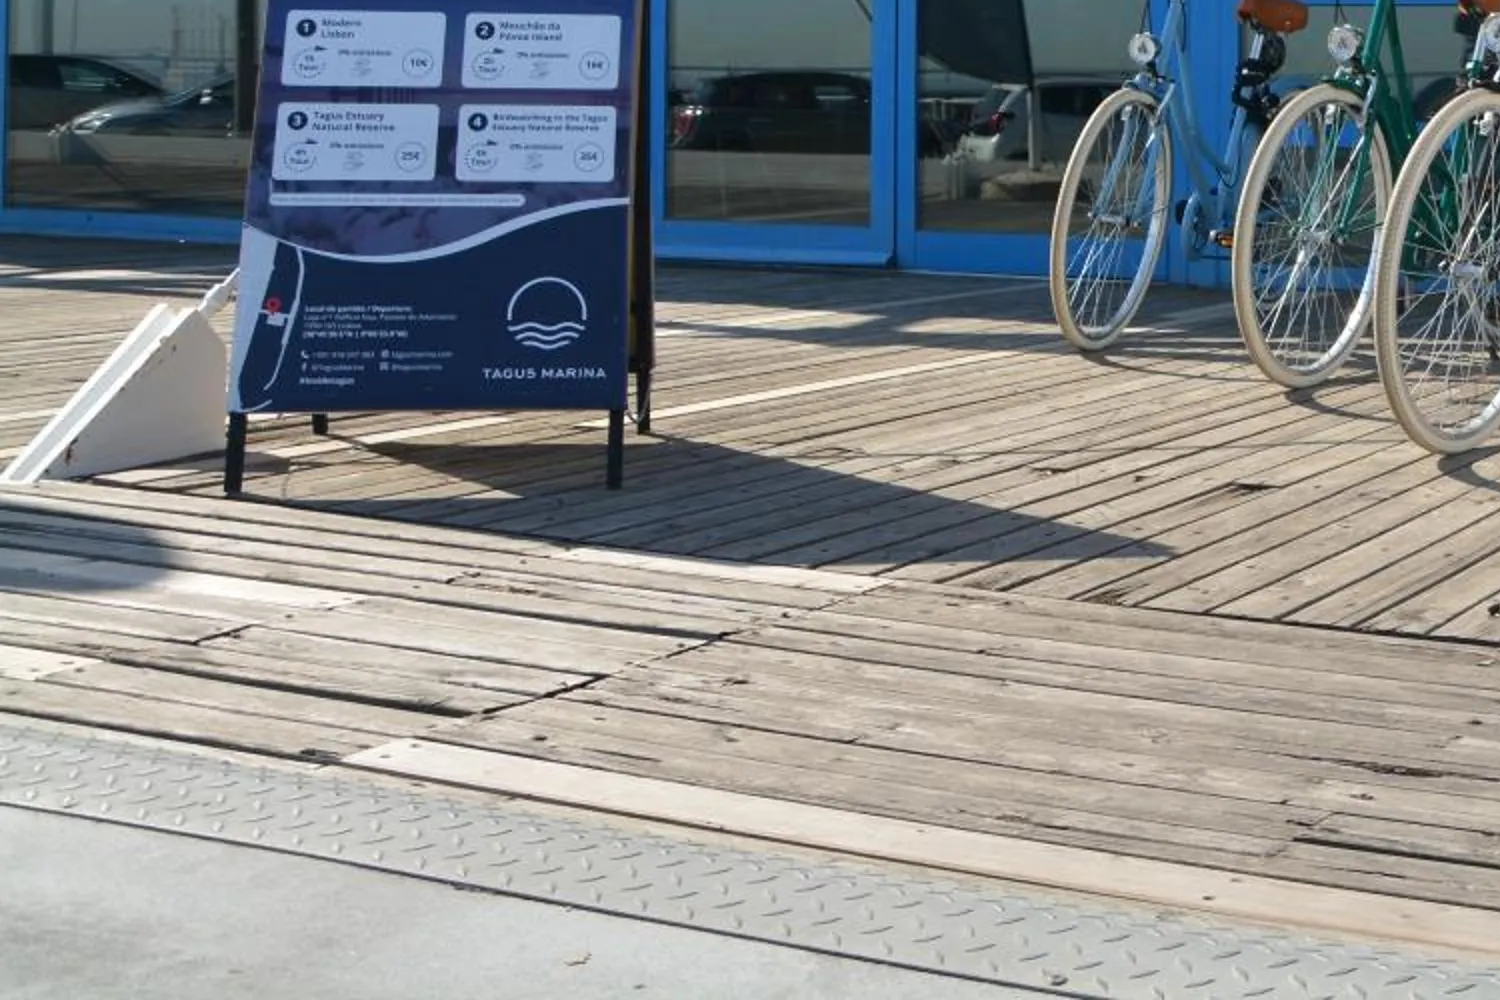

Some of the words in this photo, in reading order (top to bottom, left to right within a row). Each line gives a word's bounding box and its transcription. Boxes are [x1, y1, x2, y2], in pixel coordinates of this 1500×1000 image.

[321, 18, 362, 28] Modern
[320, 29, 356, 39] Lisbon
[313, 111, 343, 122] Tagus
[346, 111, 385, 123] Estuary
[312, 122, 353, 132] Natural
[355, 123, 396, 132] Reserve
[482, 367, 537, 379] TAGUS
[541, 367, 606, 379] MARINA
